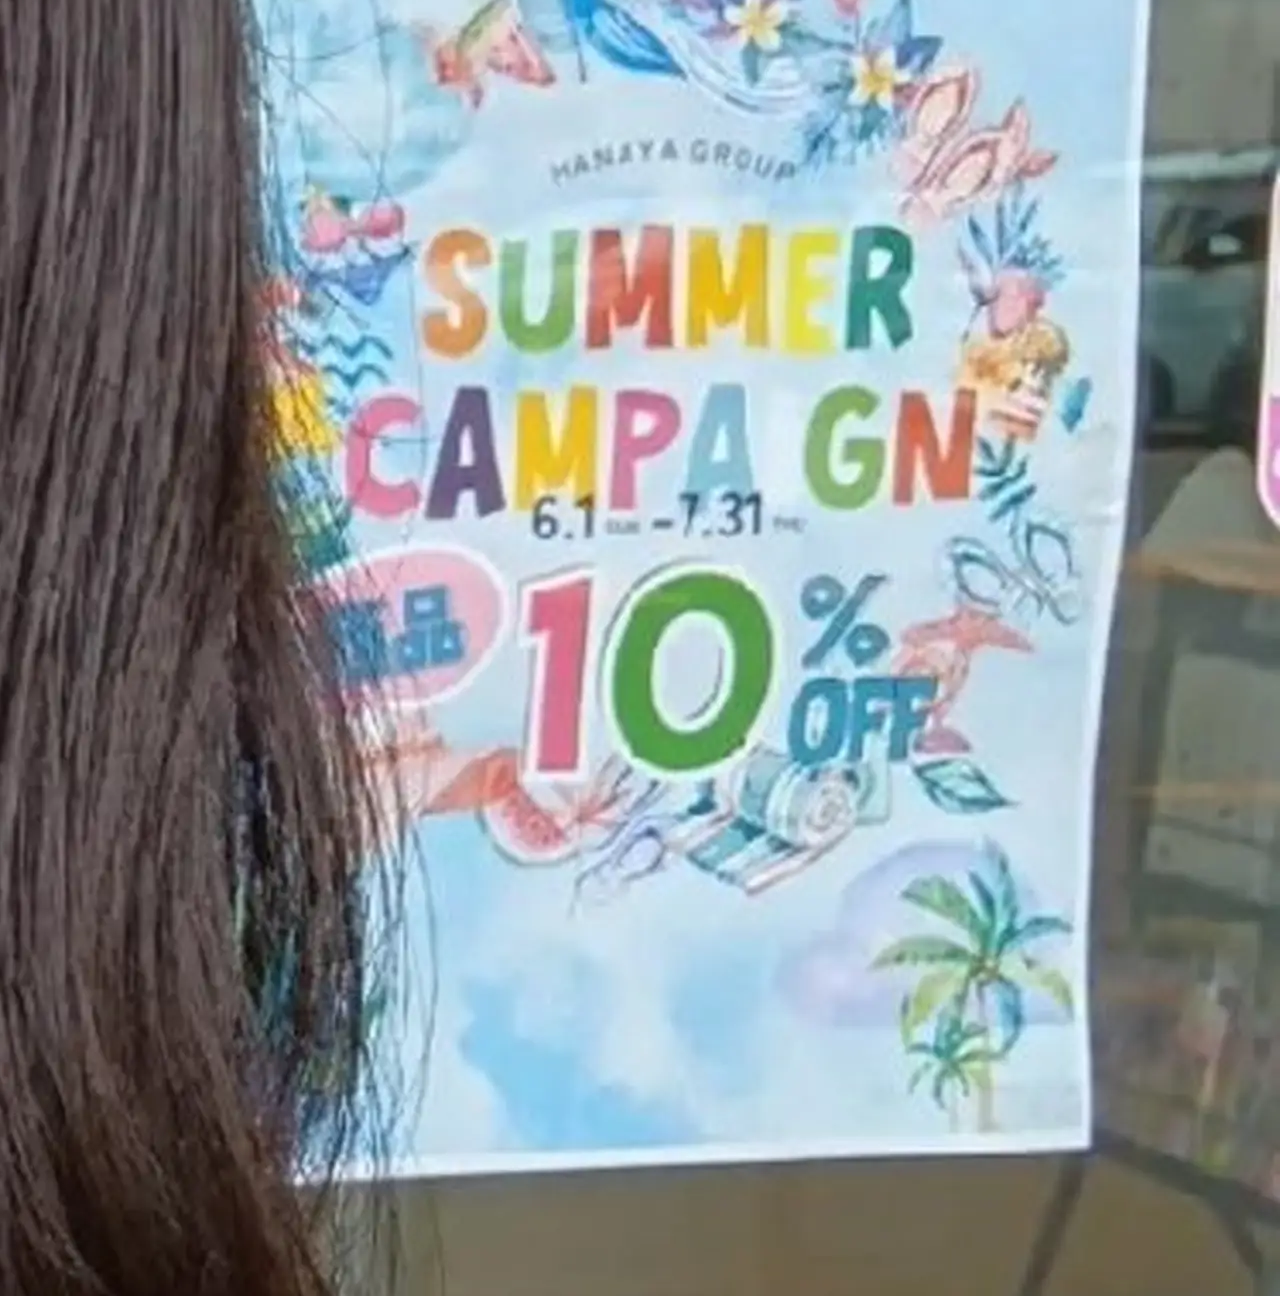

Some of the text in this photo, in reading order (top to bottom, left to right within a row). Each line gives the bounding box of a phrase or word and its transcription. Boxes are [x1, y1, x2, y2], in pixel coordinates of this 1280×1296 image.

[689, 137, 798, 182] GROUP
[421, 223, 915, 359] SUMMER
[532, 492, 596, 540] 6.1
[525, 566, 776, 775] 10
[786, 676, 939, 768] OFF
